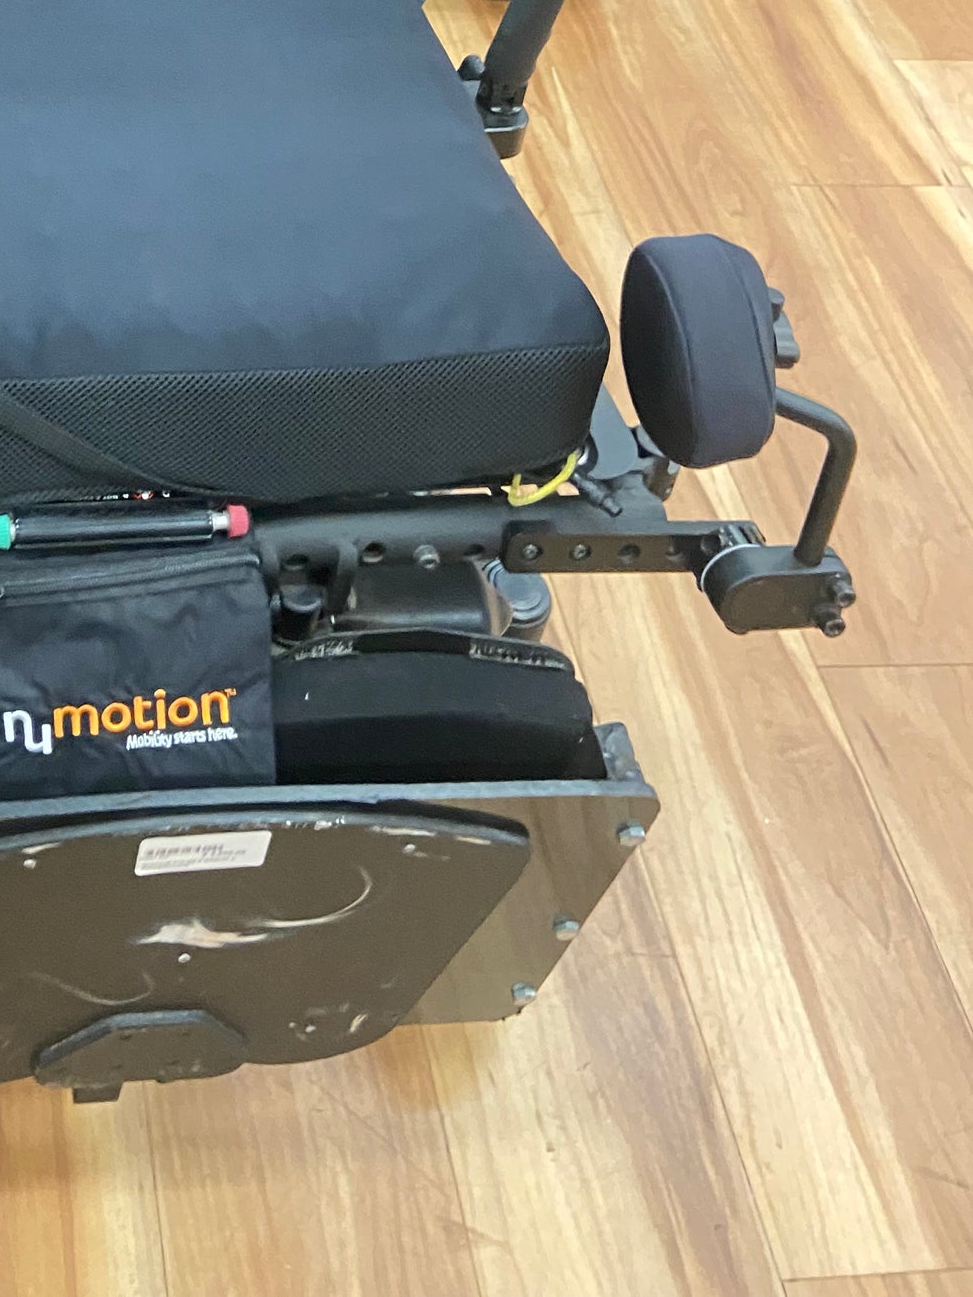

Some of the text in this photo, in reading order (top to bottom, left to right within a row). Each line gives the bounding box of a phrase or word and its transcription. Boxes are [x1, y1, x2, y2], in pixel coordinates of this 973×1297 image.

[126, 726, 239, 750] Mobility starts here.
